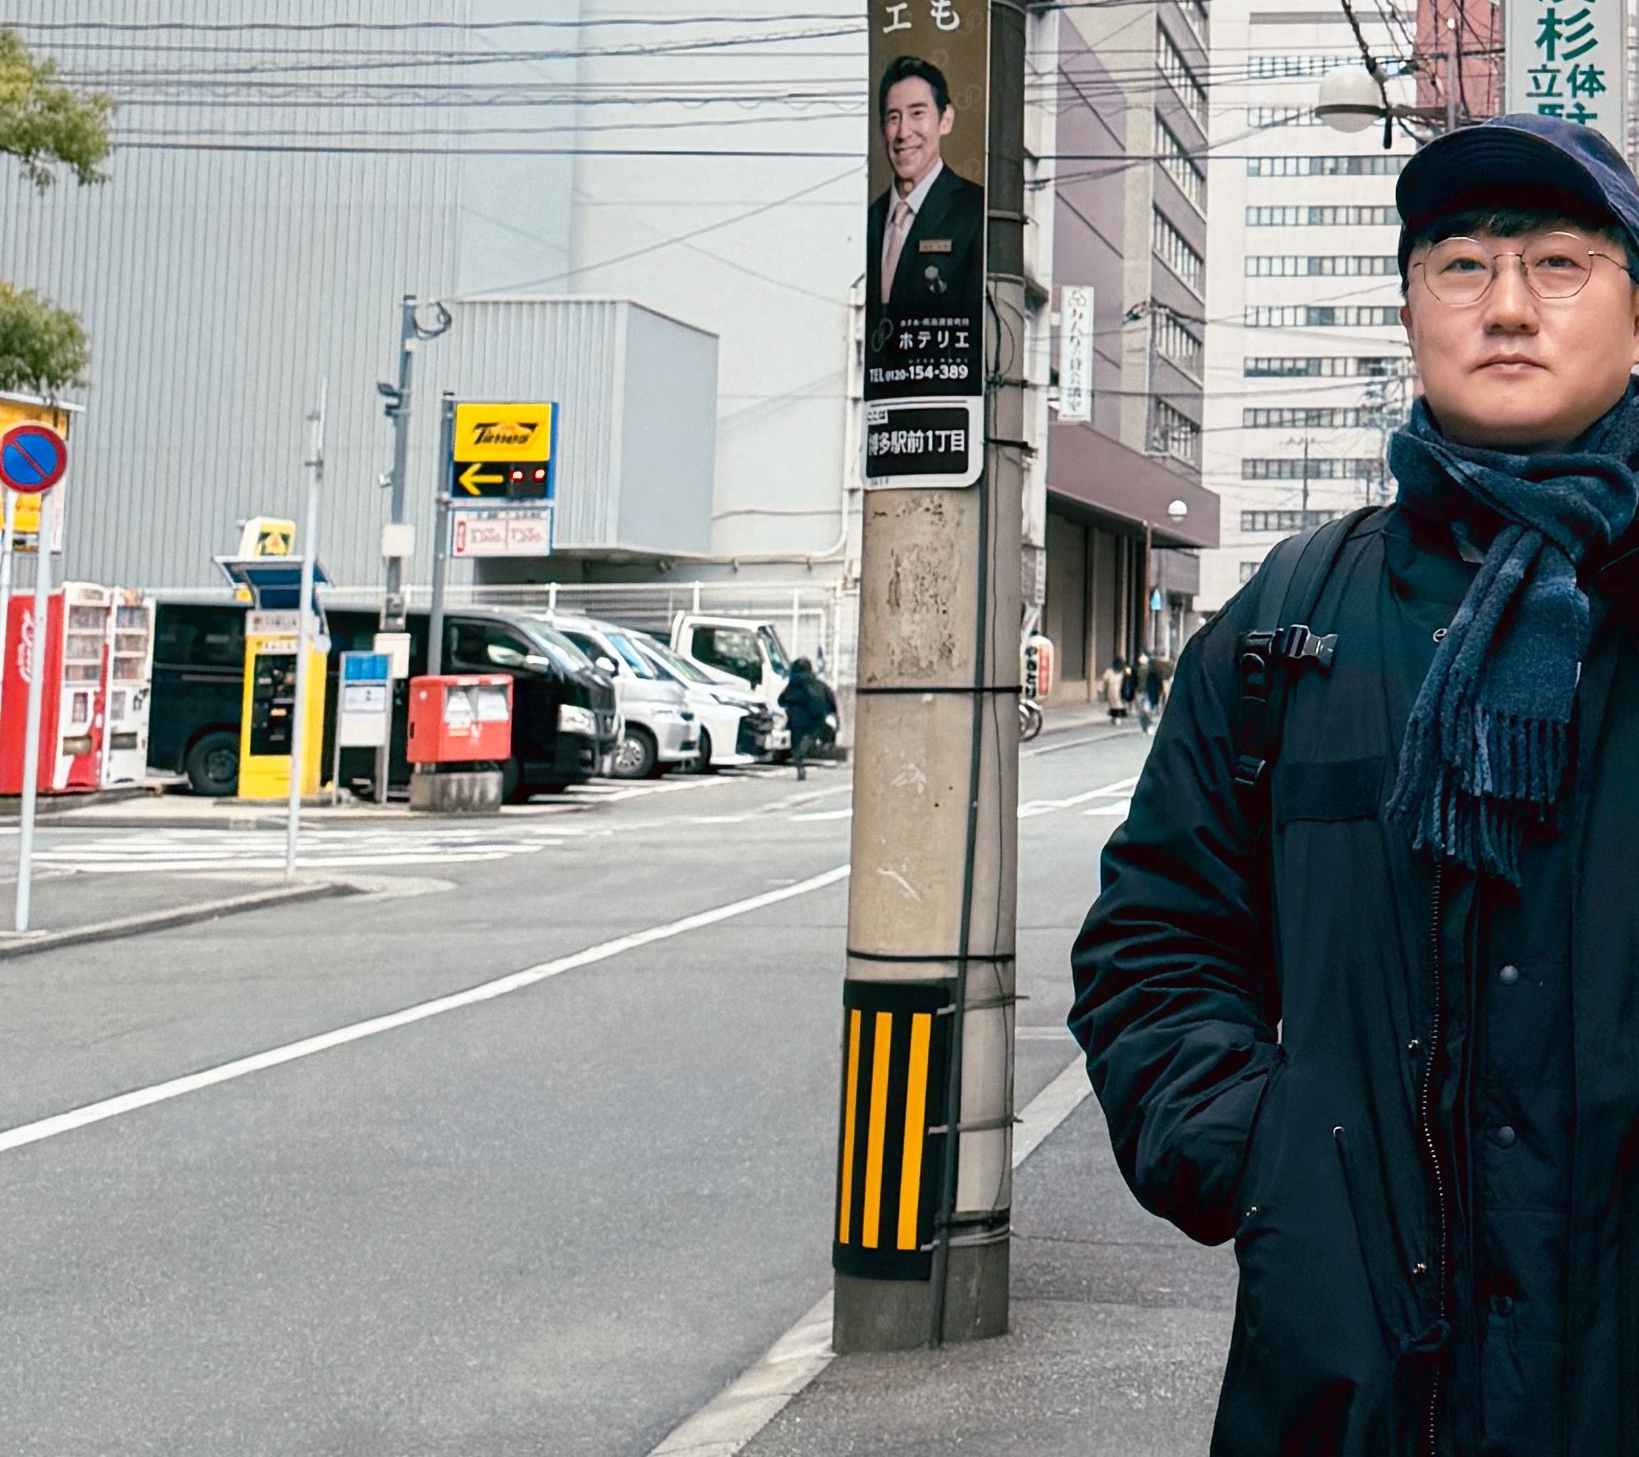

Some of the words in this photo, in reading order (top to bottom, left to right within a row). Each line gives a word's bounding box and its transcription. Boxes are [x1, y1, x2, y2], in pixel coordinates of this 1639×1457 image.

[899, 330, 970, 351] ホテリエ
[869, 368, 884, 384] TEL
[868, 428, 966, 457] 博多駅前1丁目
